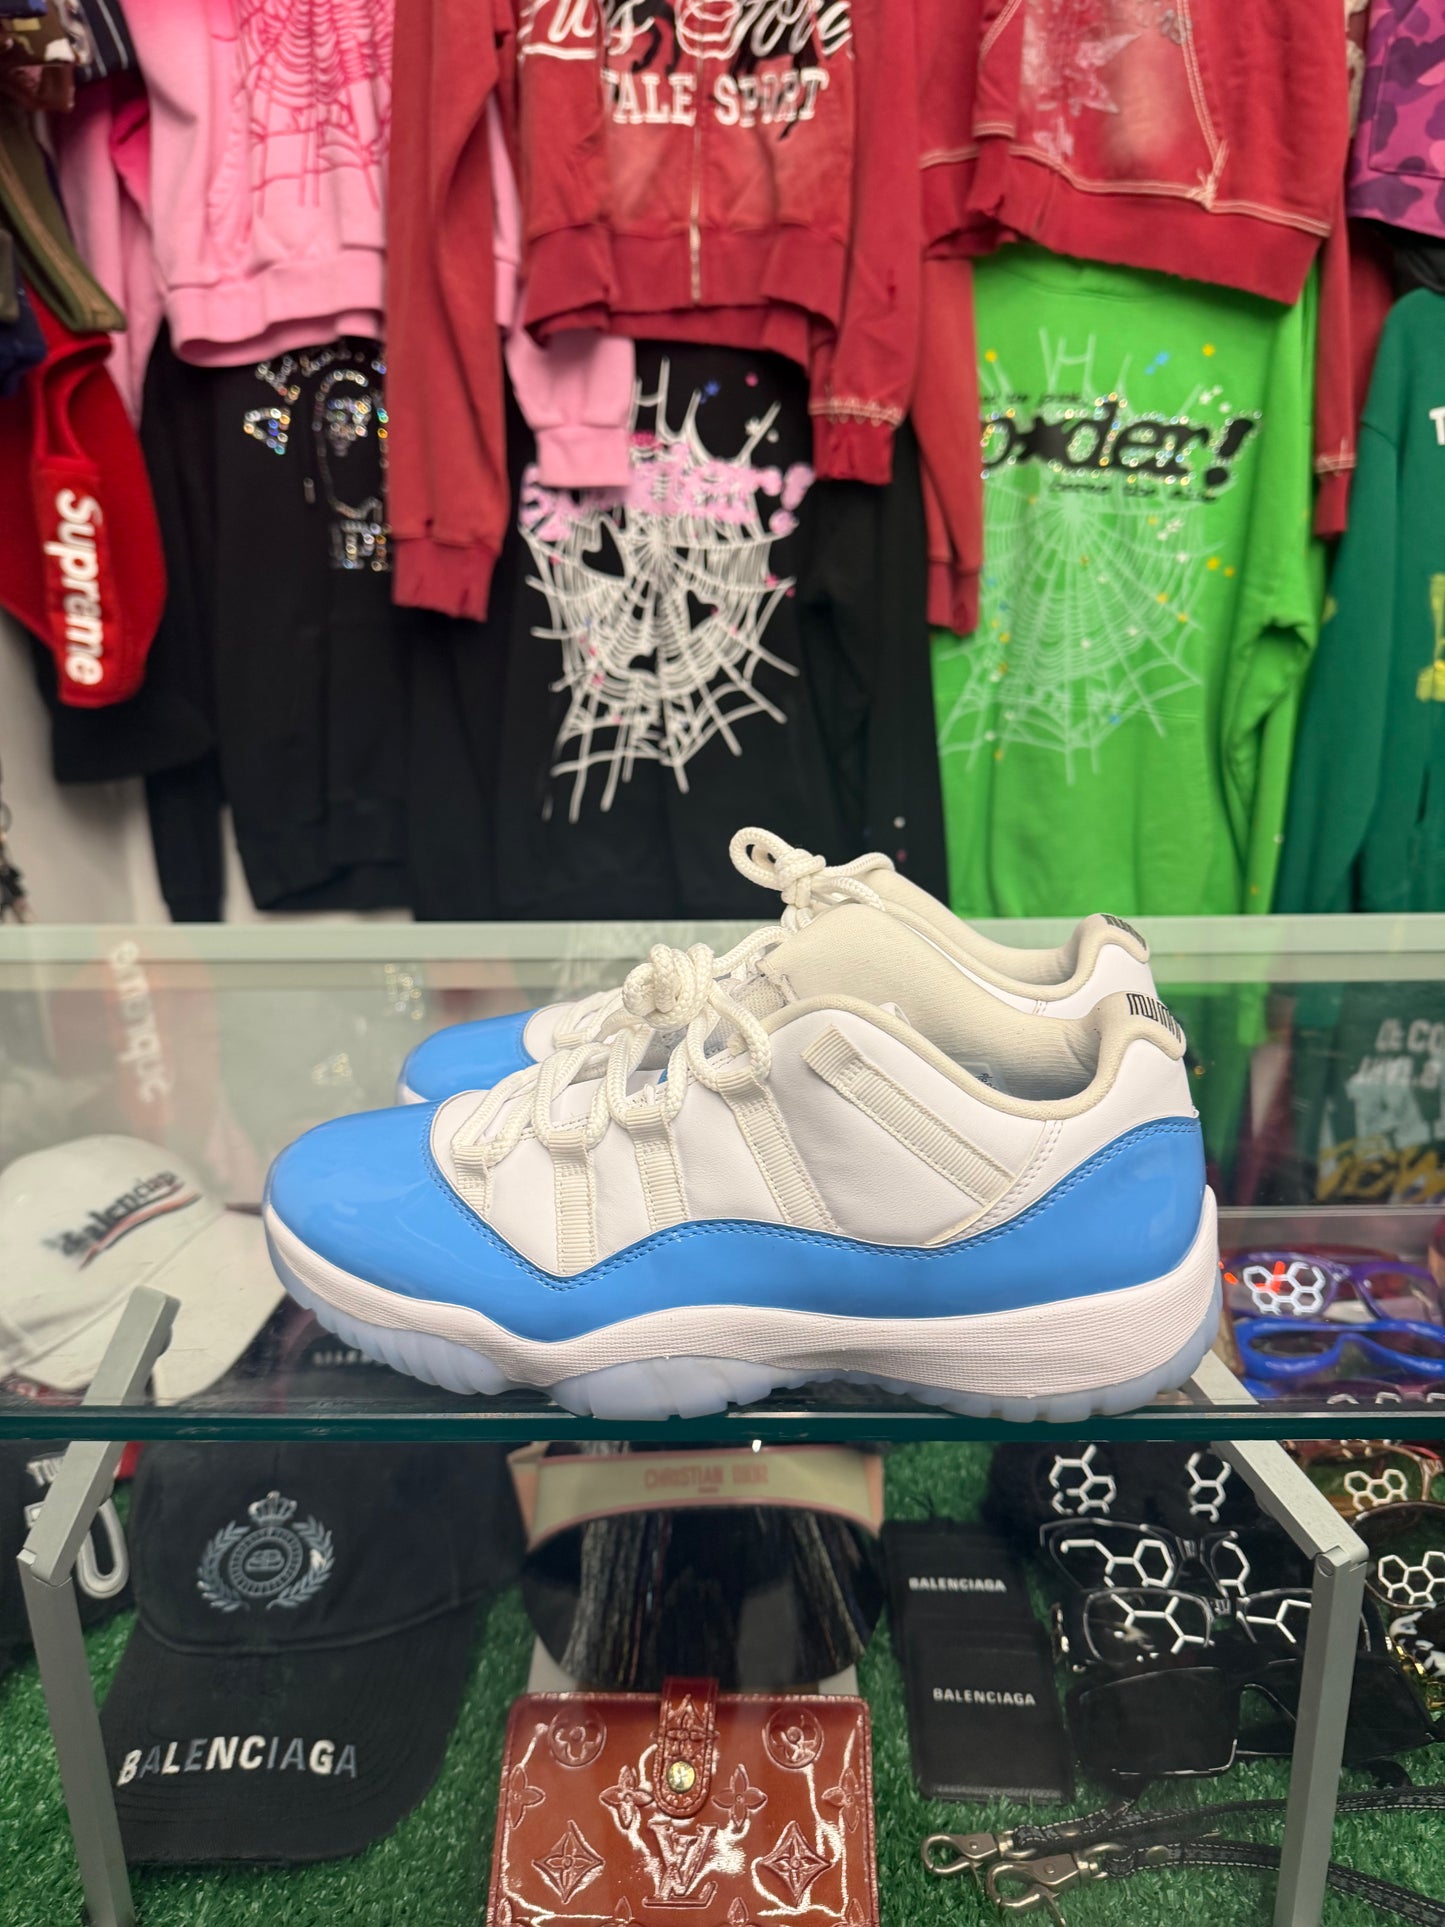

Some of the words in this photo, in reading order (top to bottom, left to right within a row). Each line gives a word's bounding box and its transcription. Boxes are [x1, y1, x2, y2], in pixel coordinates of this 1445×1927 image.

[44, 488, 104, 686] Supreme
[908, 1577, 1008, 1593] BALENCIAGA
[932, 1687, 1037, 1707] BALENCIAGA
[117, 1735, 357, 1786] BALENCIAGA
